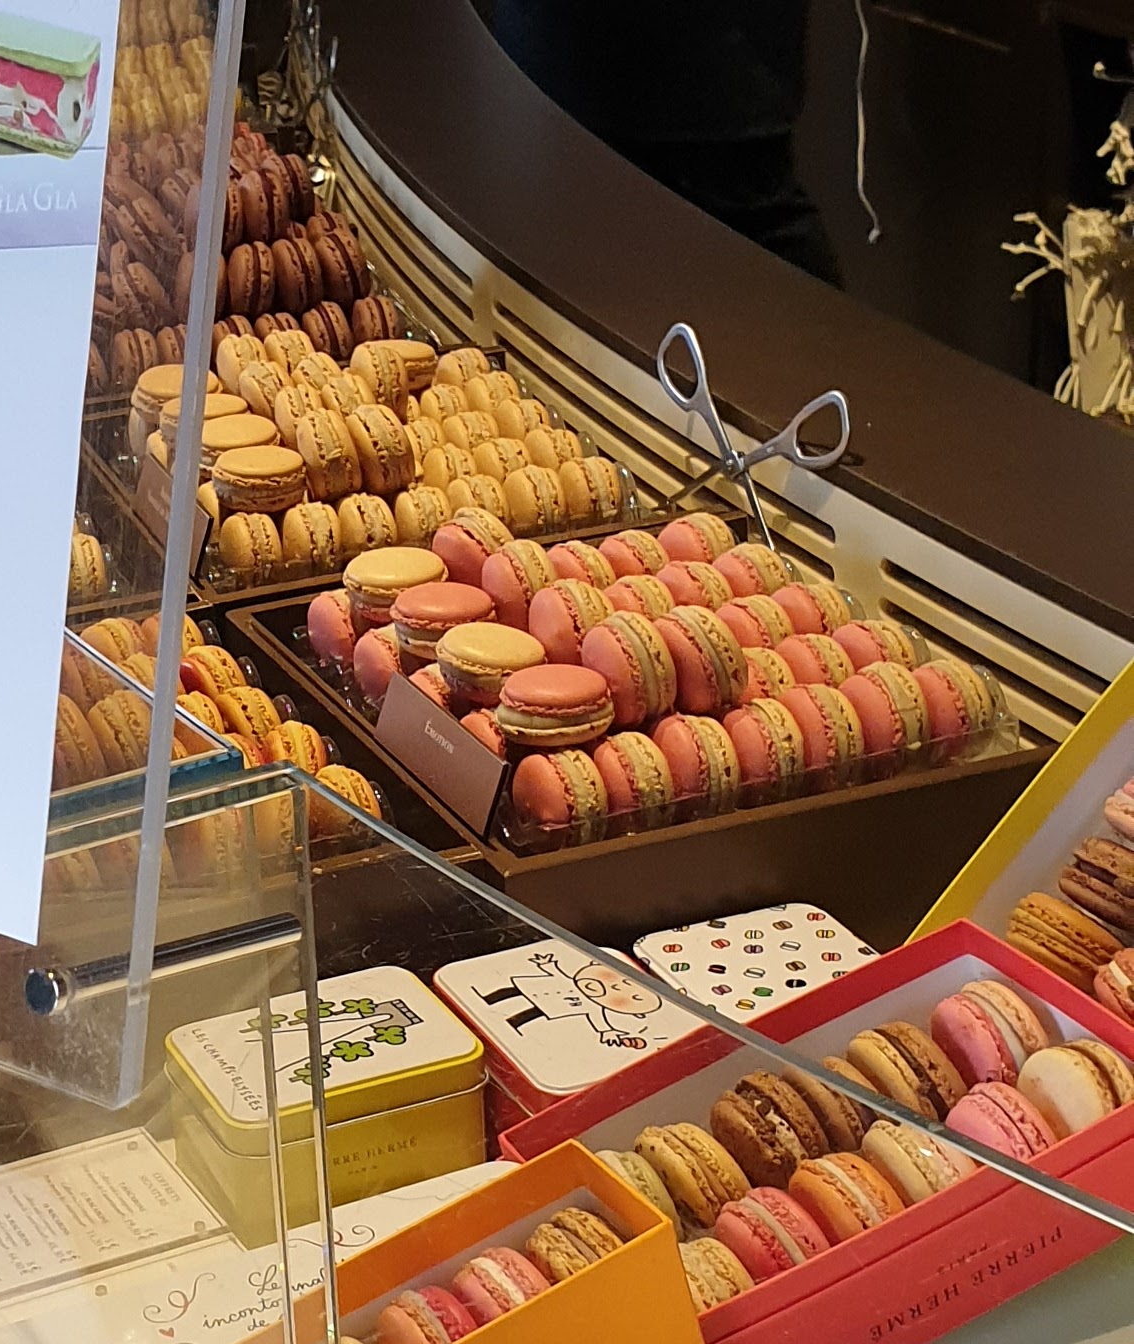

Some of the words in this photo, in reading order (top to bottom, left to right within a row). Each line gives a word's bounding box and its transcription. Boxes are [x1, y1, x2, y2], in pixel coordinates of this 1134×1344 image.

[191, 1028, 209, 1043] LES
[972, 1226, 1063, 1286] PIERRE
[203, 1297, 282, 1329] inconto
[869, 1283, 960, 1342] HERMÉ
